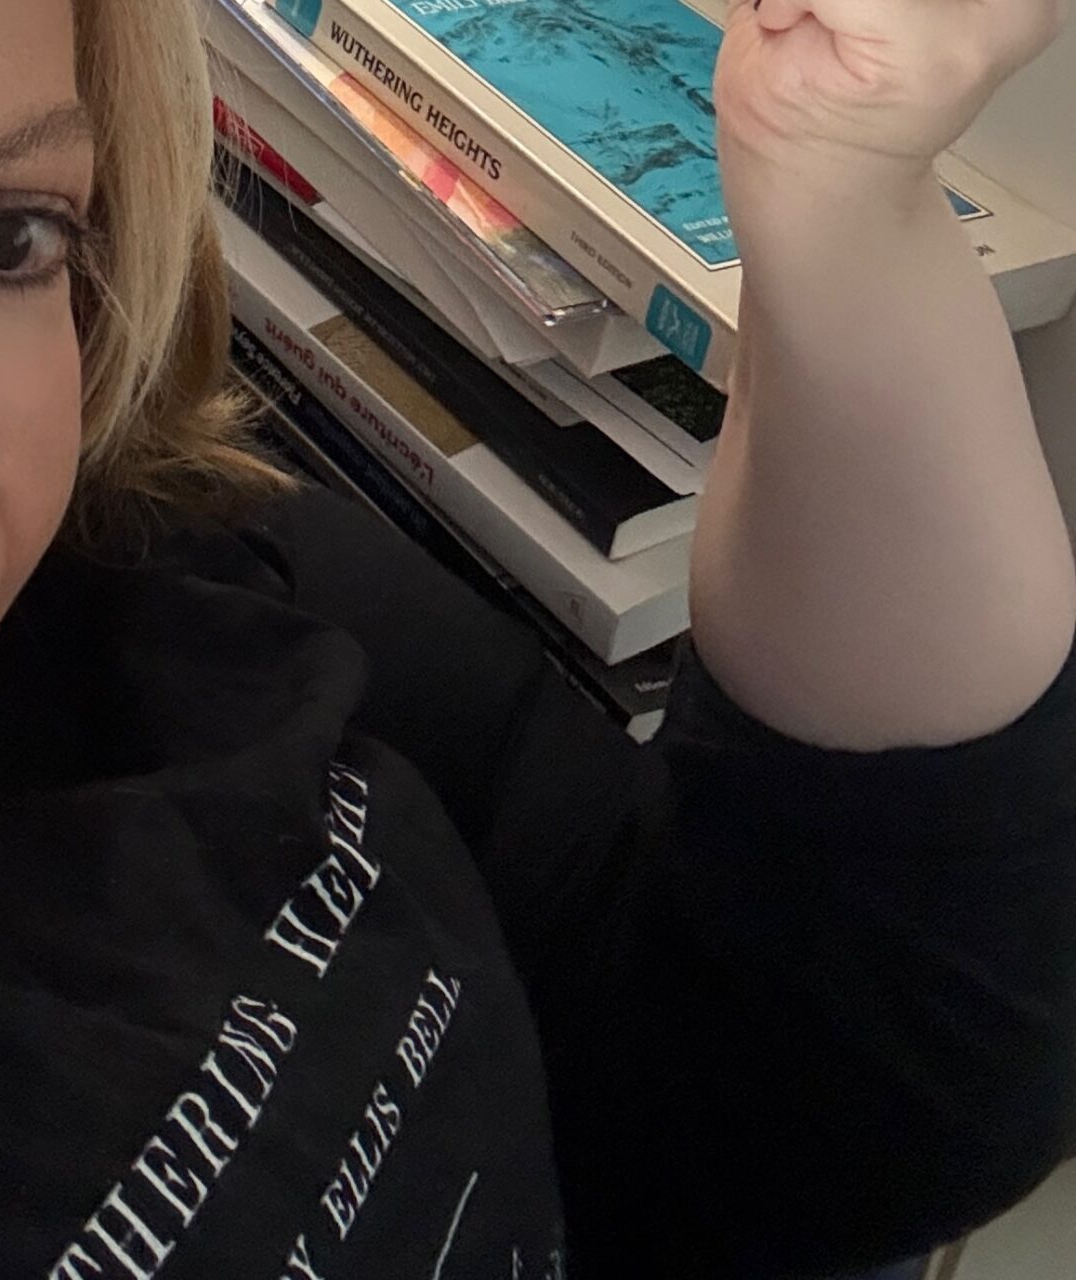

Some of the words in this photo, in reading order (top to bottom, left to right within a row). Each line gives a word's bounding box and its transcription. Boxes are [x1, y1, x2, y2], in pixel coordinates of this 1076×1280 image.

[330, 21, 423, 113] WUTHERING
[426, 104, 502, 180] HEIGHTS
[318, 366, 346, 400] qui
[321, 1082, 401, 1240] ELLIS
[395, 968, 461, 1088] BELL
